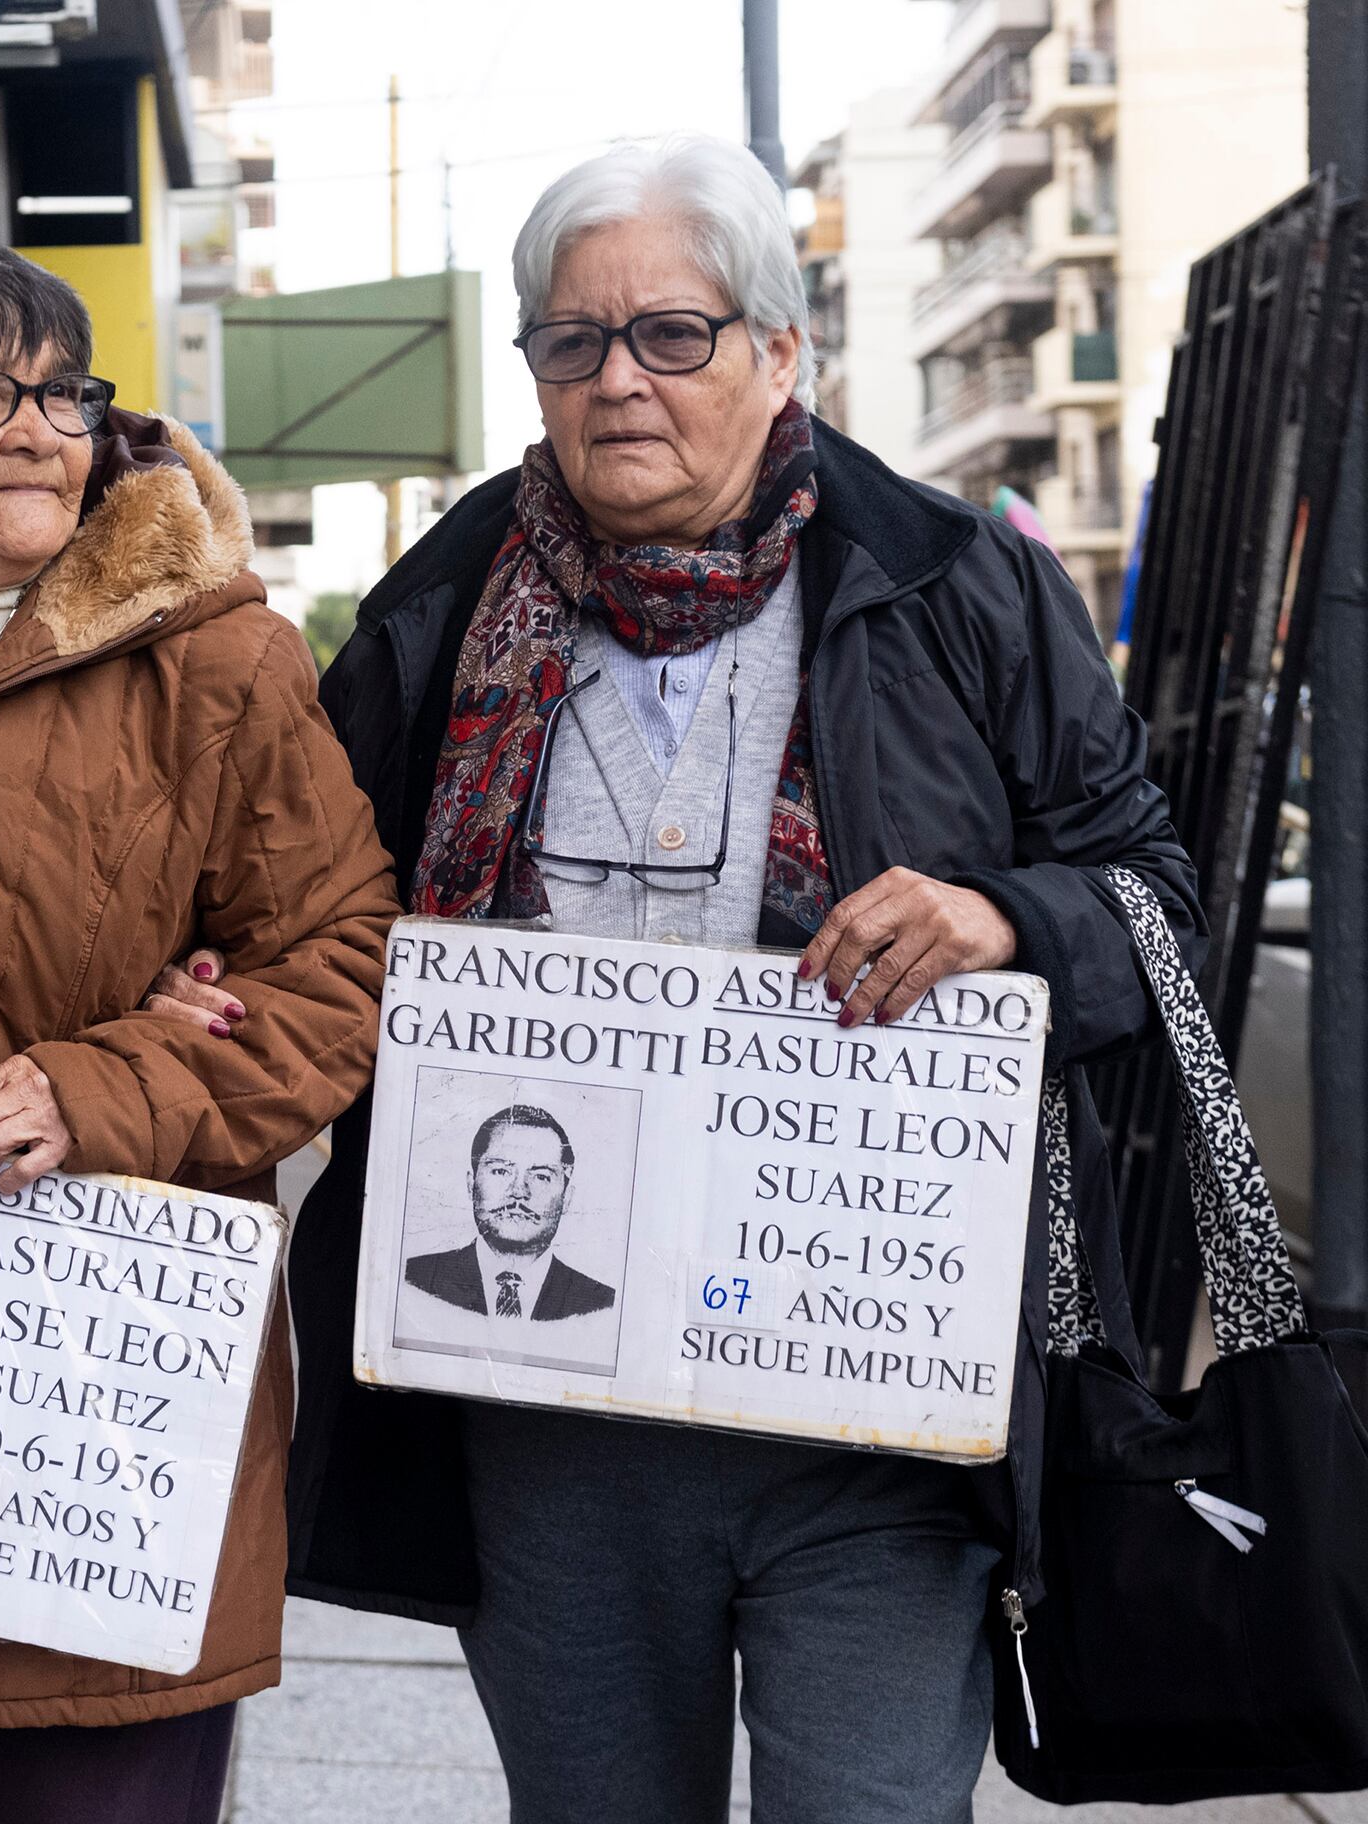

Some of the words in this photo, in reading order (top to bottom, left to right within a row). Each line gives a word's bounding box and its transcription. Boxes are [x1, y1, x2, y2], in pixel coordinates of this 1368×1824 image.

[386, 937, 700, 1009] FRANCISCO
[713, 965, 1032, 1033] ASESADO
[386, 1003, 689, 1076] GARIBOTTI
[700, 1026, 1021, 1098] BASURALES
[705, 1091, 839, 1146] JOSE
[855, 1107, 1018, 1165] LEON
[755, 1163, 954, 1219] SUAREZ
[736, 1220, 966, 1285] 10-6-1956
[702, 1274, 753, 1315] 67
[784, 1285, 908, 1334] AÑOS
[923, 1304, 955, 1338] Y
[84, 1314, 239, 1385] LEON
[680, 1327, 809, 1375] SIGUE
[823, 1345, 996, 1397] IMPUNE
[131, 1515, 162, 1552] Y
[28, 1548, 196, 1614] IMPUNE
